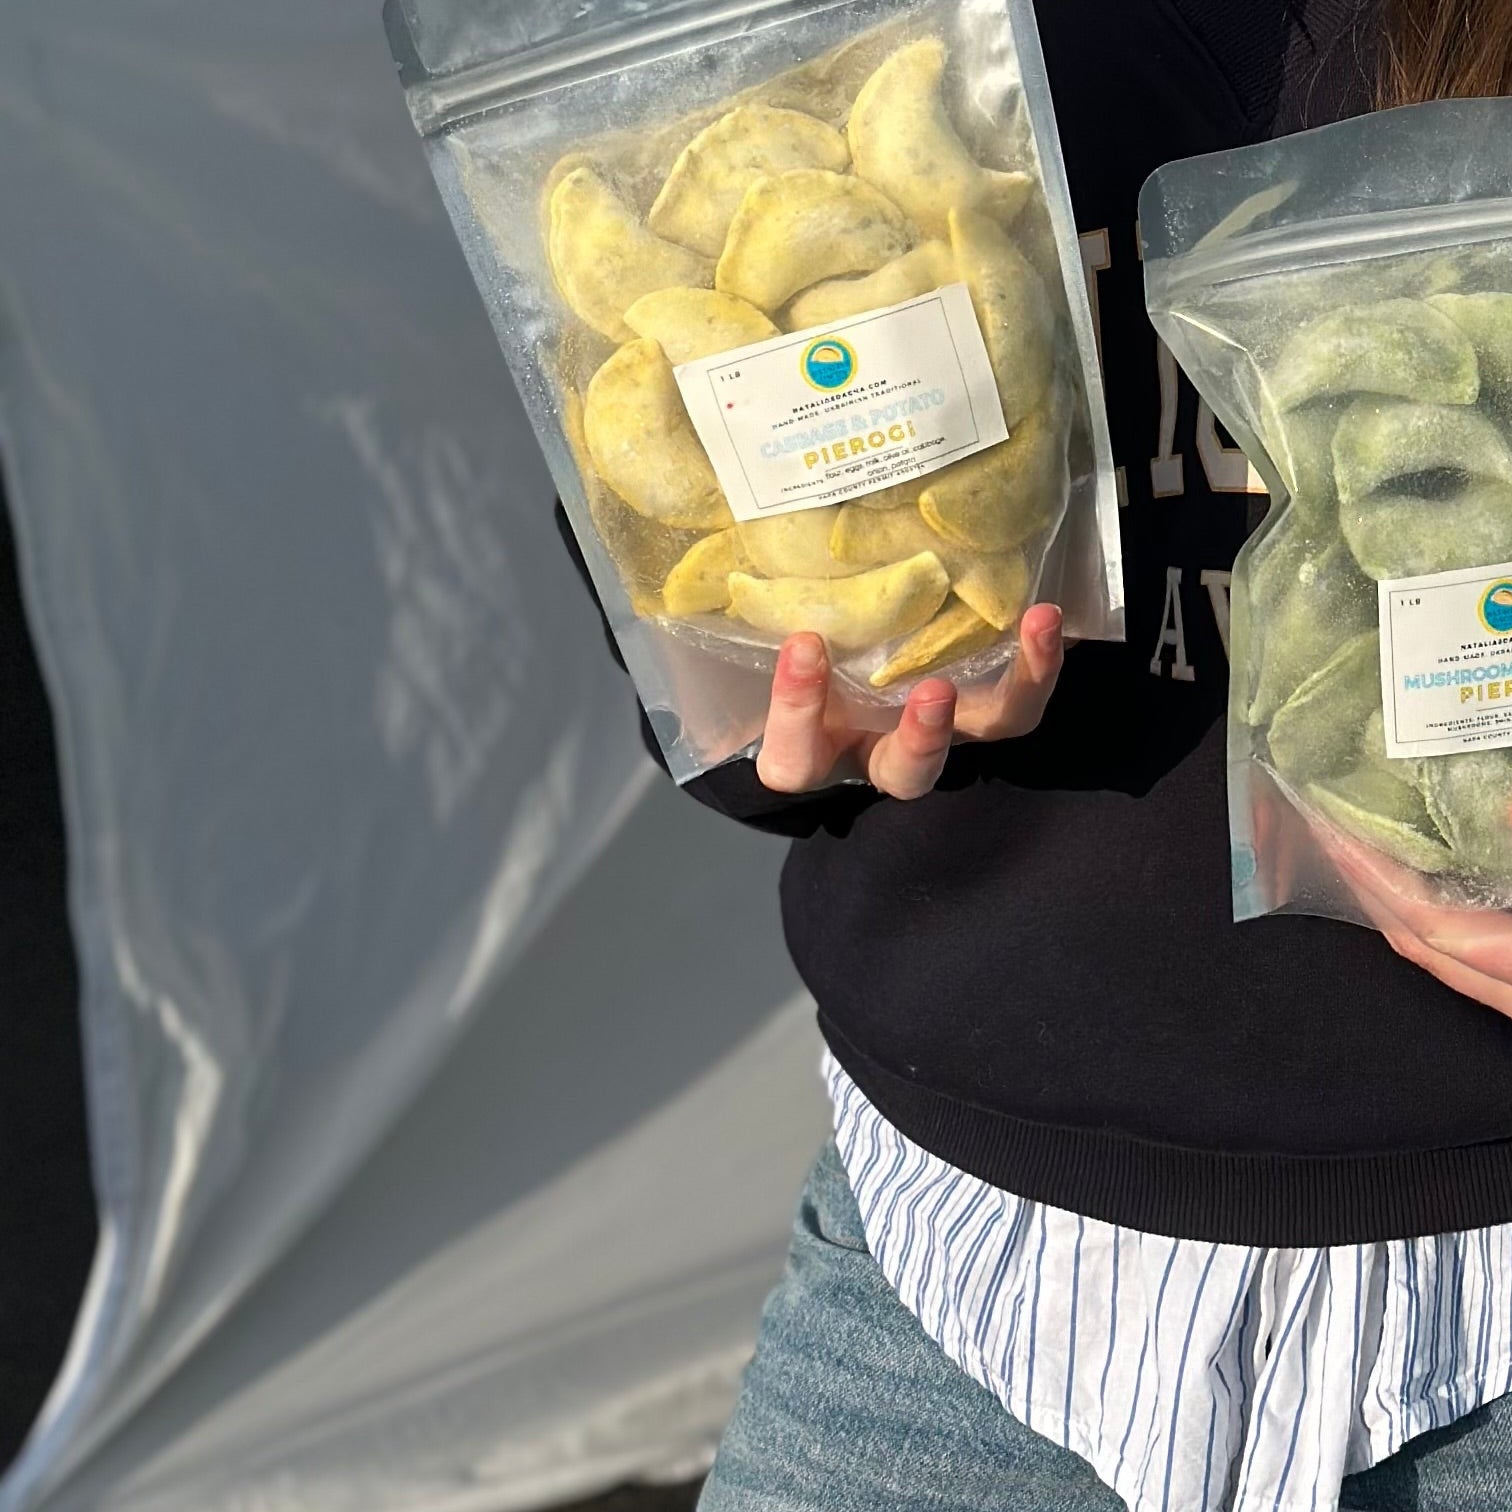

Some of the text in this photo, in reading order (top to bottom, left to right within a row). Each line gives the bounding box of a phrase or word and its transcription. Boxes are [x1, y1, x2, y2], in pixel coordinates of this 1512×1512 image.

[729, 371, 741, 380] LB
[850, 413, 868, 433] &
[869, 388, 945, 426] POTATO
[804, 420, 917, 470] PIEROGI
[1409, 598, 1421, 606] LB
